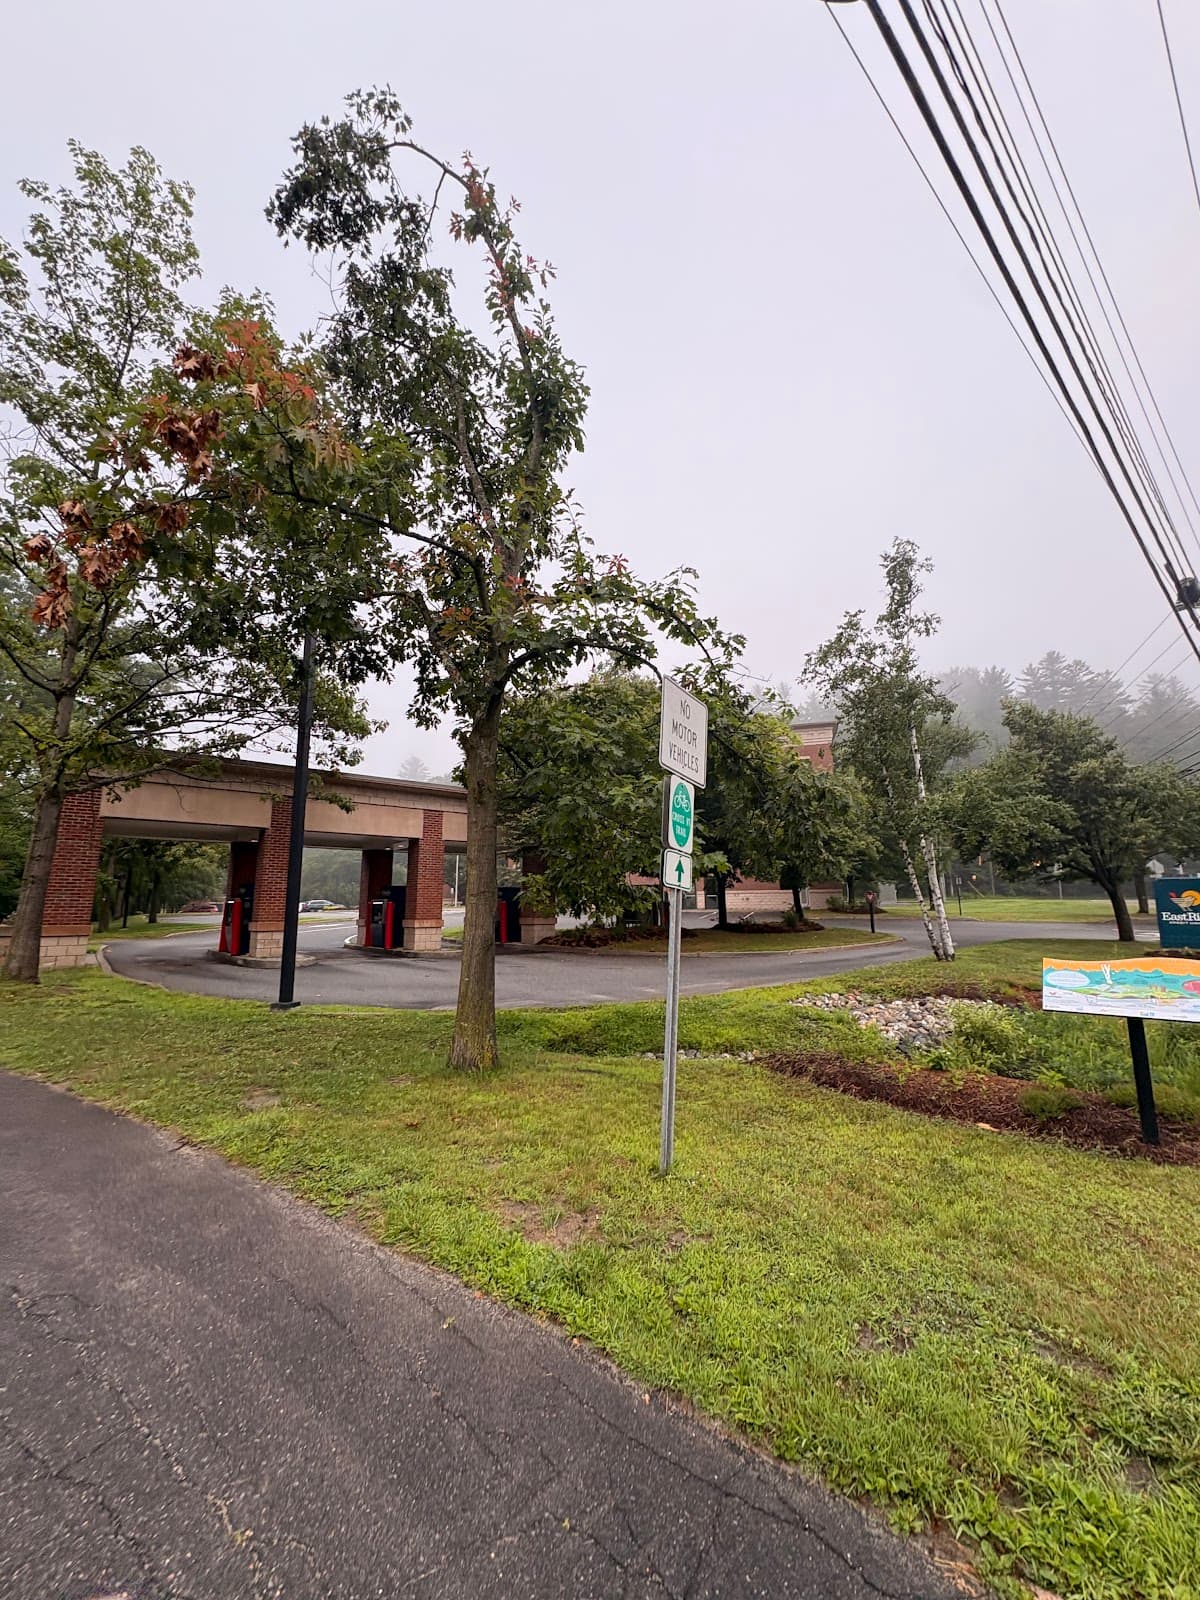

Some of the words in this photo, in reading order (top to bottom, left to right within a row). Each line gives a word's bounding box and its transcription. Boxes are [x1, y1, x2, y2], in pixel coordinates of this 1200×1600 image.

[680, 699, 690, 719] NO
[672, 718, 697, 748] MOTOR
[669, 740, 698, 772] VEHICLES
